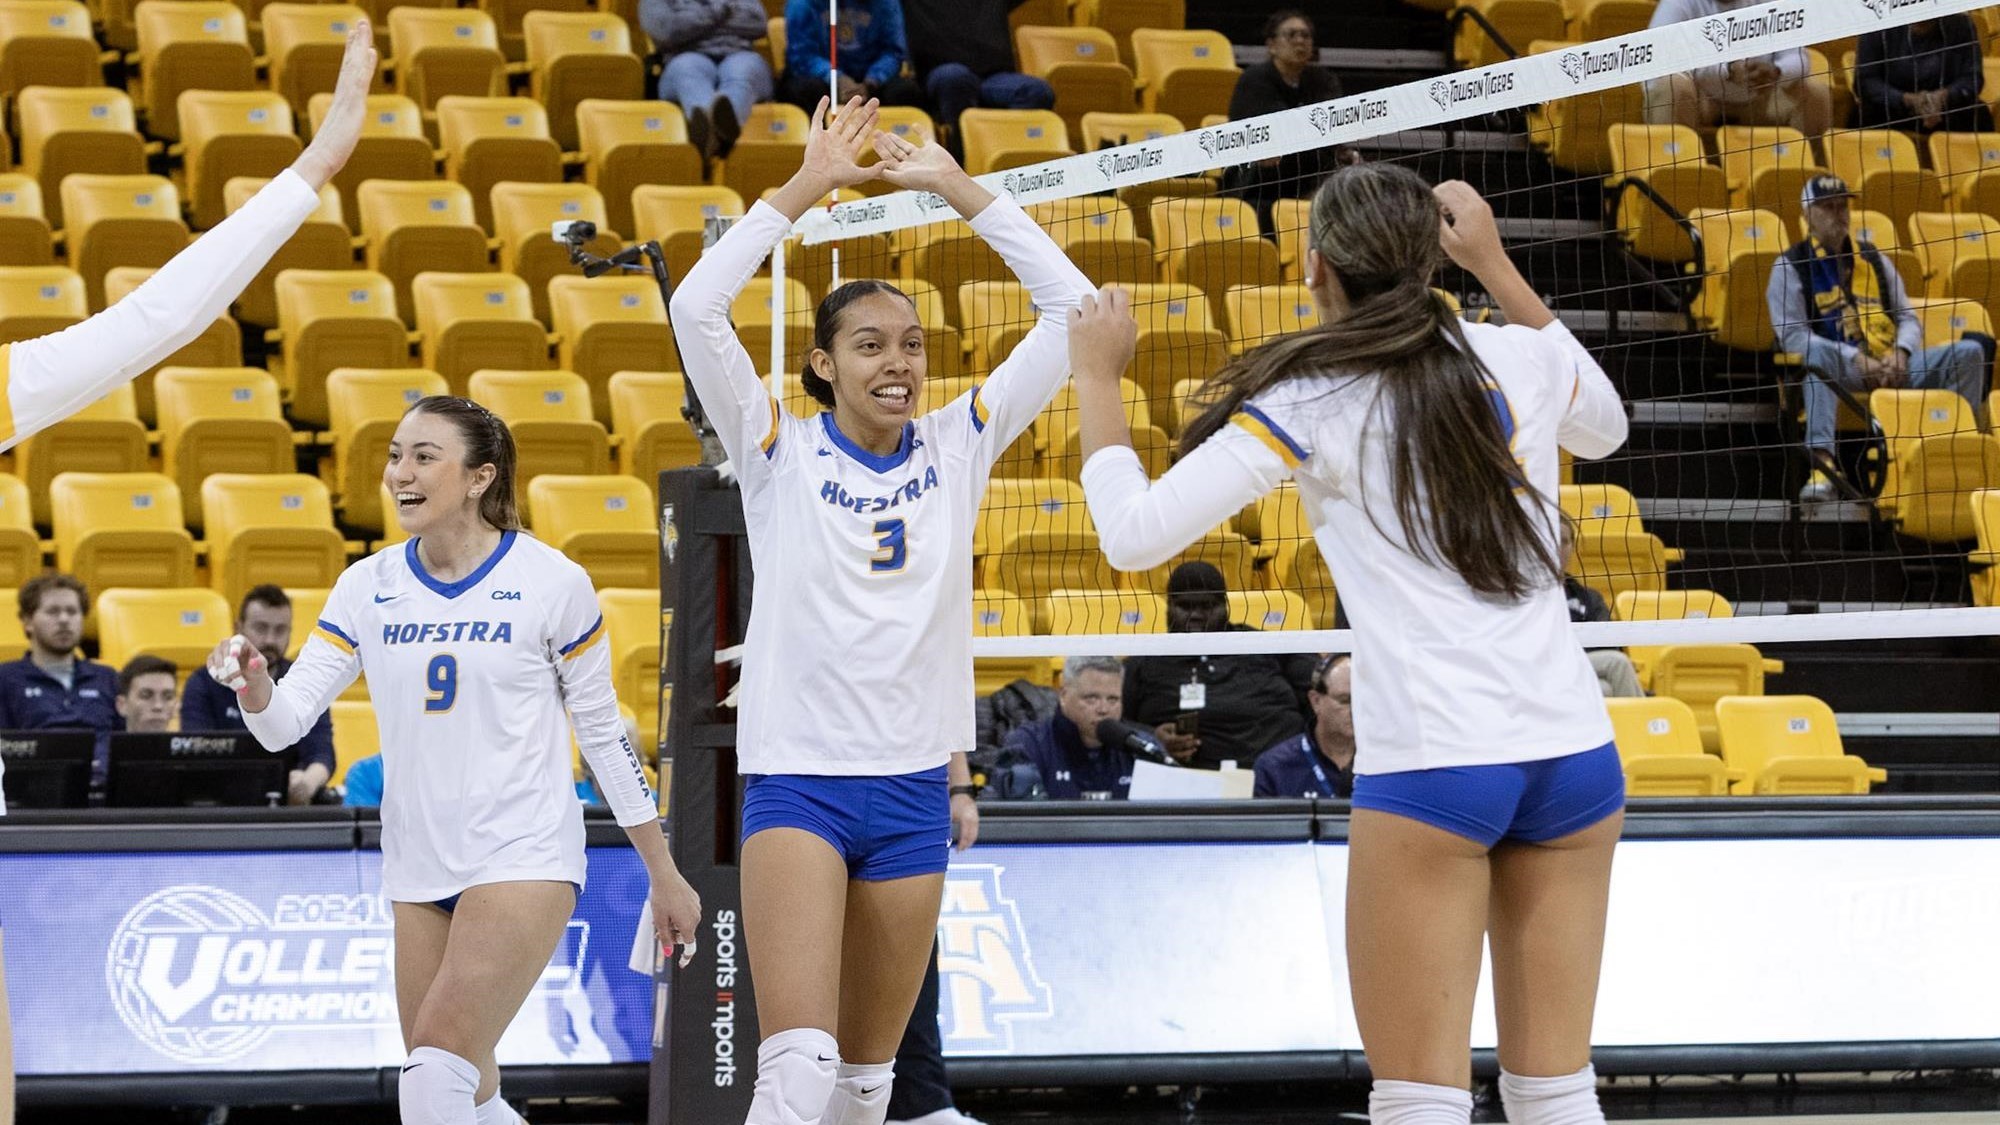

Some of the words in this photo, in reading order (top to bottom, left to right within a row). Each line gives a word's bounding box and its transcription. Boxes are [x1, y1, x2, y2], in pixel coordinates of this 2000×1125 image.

[820, 465, 939, 513] HOFSTRA
[869, 517, 909, 574] 3
[491, 590, 521, 601] CAA
[382, 620, 513, 645] HOFSTRA
[424, 651, 458, 715] 9
[712, 909, 738, 988] sports
